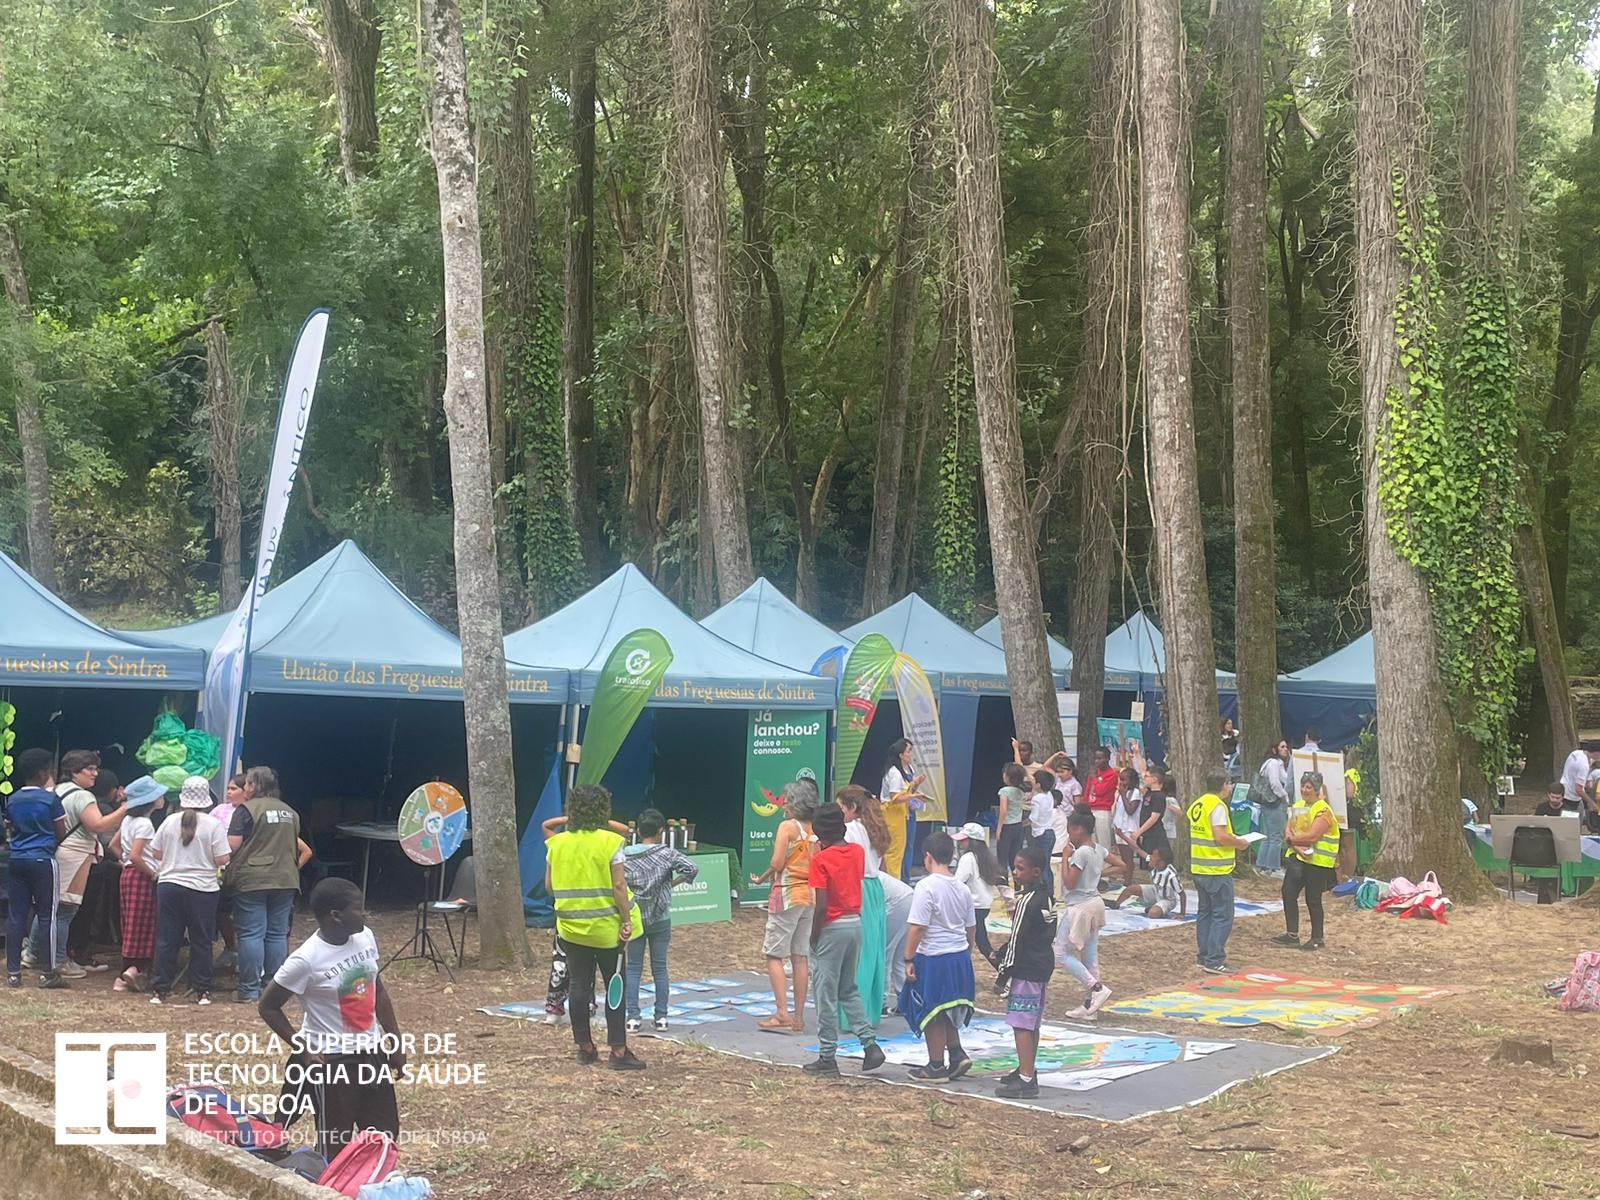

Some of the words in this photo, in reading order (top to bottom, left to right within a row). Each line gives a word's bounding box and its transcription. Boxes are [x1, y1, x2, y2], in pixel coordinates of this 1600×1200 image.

[0, 653, 69, 673] uesias
[75, 651, 101, 674] de
[105, 655, 168, 678] Sintra
[282, 658, 339, 682] União
[343, 660, 376, 685] das
[380, 664, 464, 693] Freguesia
[655, 678, 680, 698] das
[683, 680, 754, 704] Freguesias
[757, 680, 773, 700] de
[776, 682, 816, 700] Sintra
[755, 709, 772, 722] Já
[754, 722, 820, 737] lanchou?
[753, 747, 793, 755] connosco.
